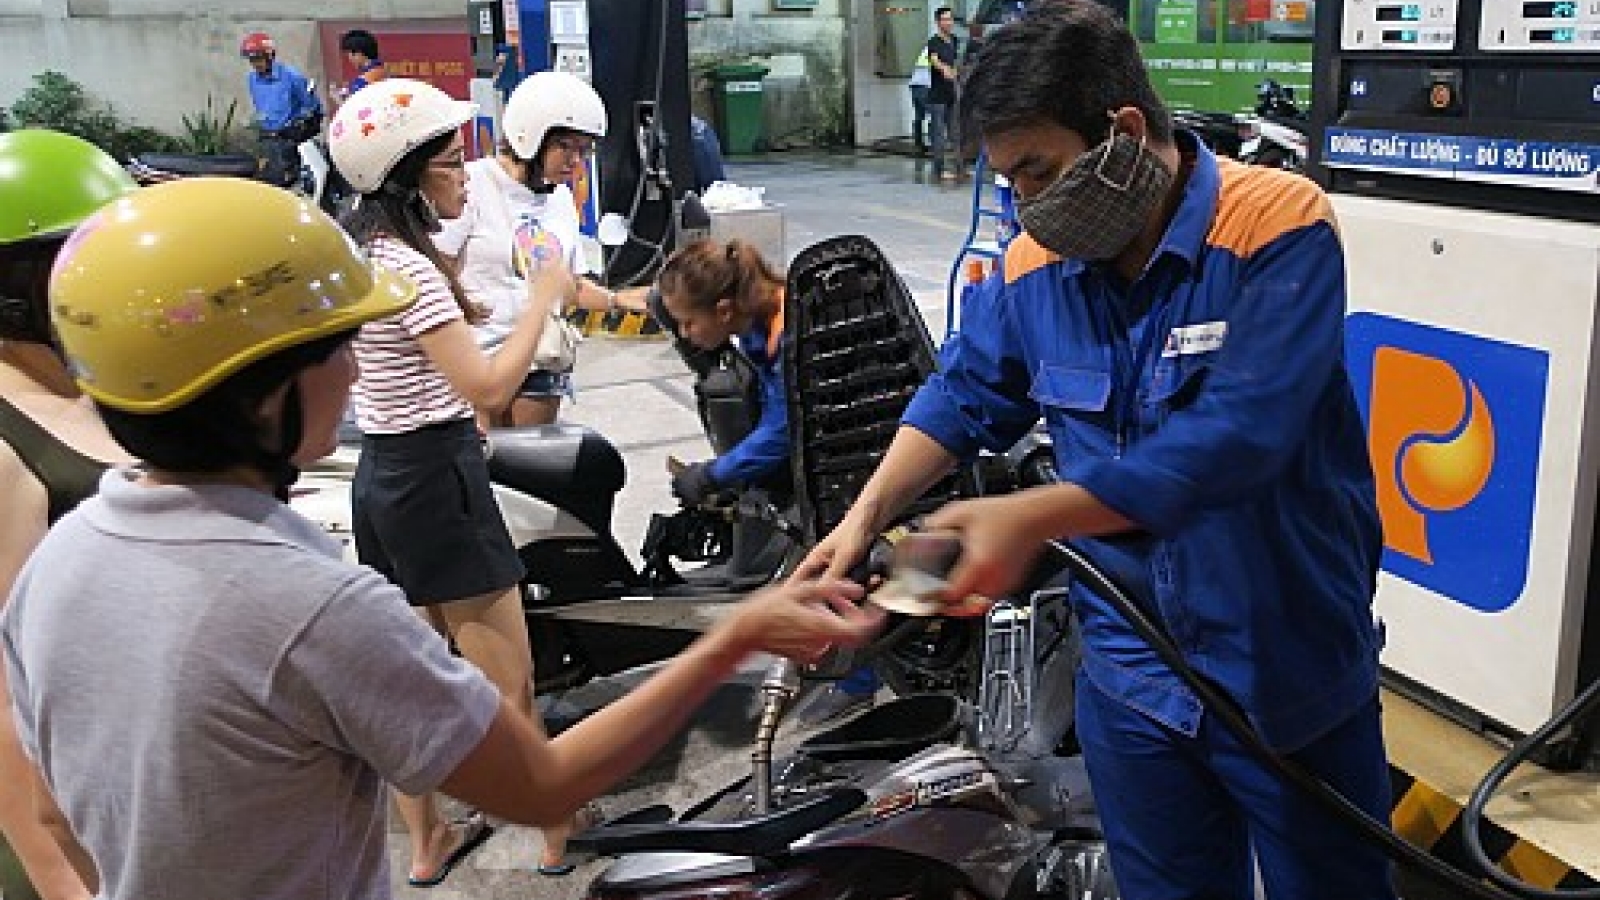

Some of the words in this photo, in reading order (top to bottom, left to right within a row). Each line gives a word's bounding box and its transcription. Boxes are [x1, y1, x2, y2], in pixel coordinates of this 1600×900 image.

[1370, 134, 1408, 157] CHẤT
[1411, 138, 1460, 164] LƯỢNG
[1475, 142, 1499, 166] ĐỦ
[1503, 142, 1527, 168] SỐ
[1532, 147, 1591, 176] LƯỢNG
